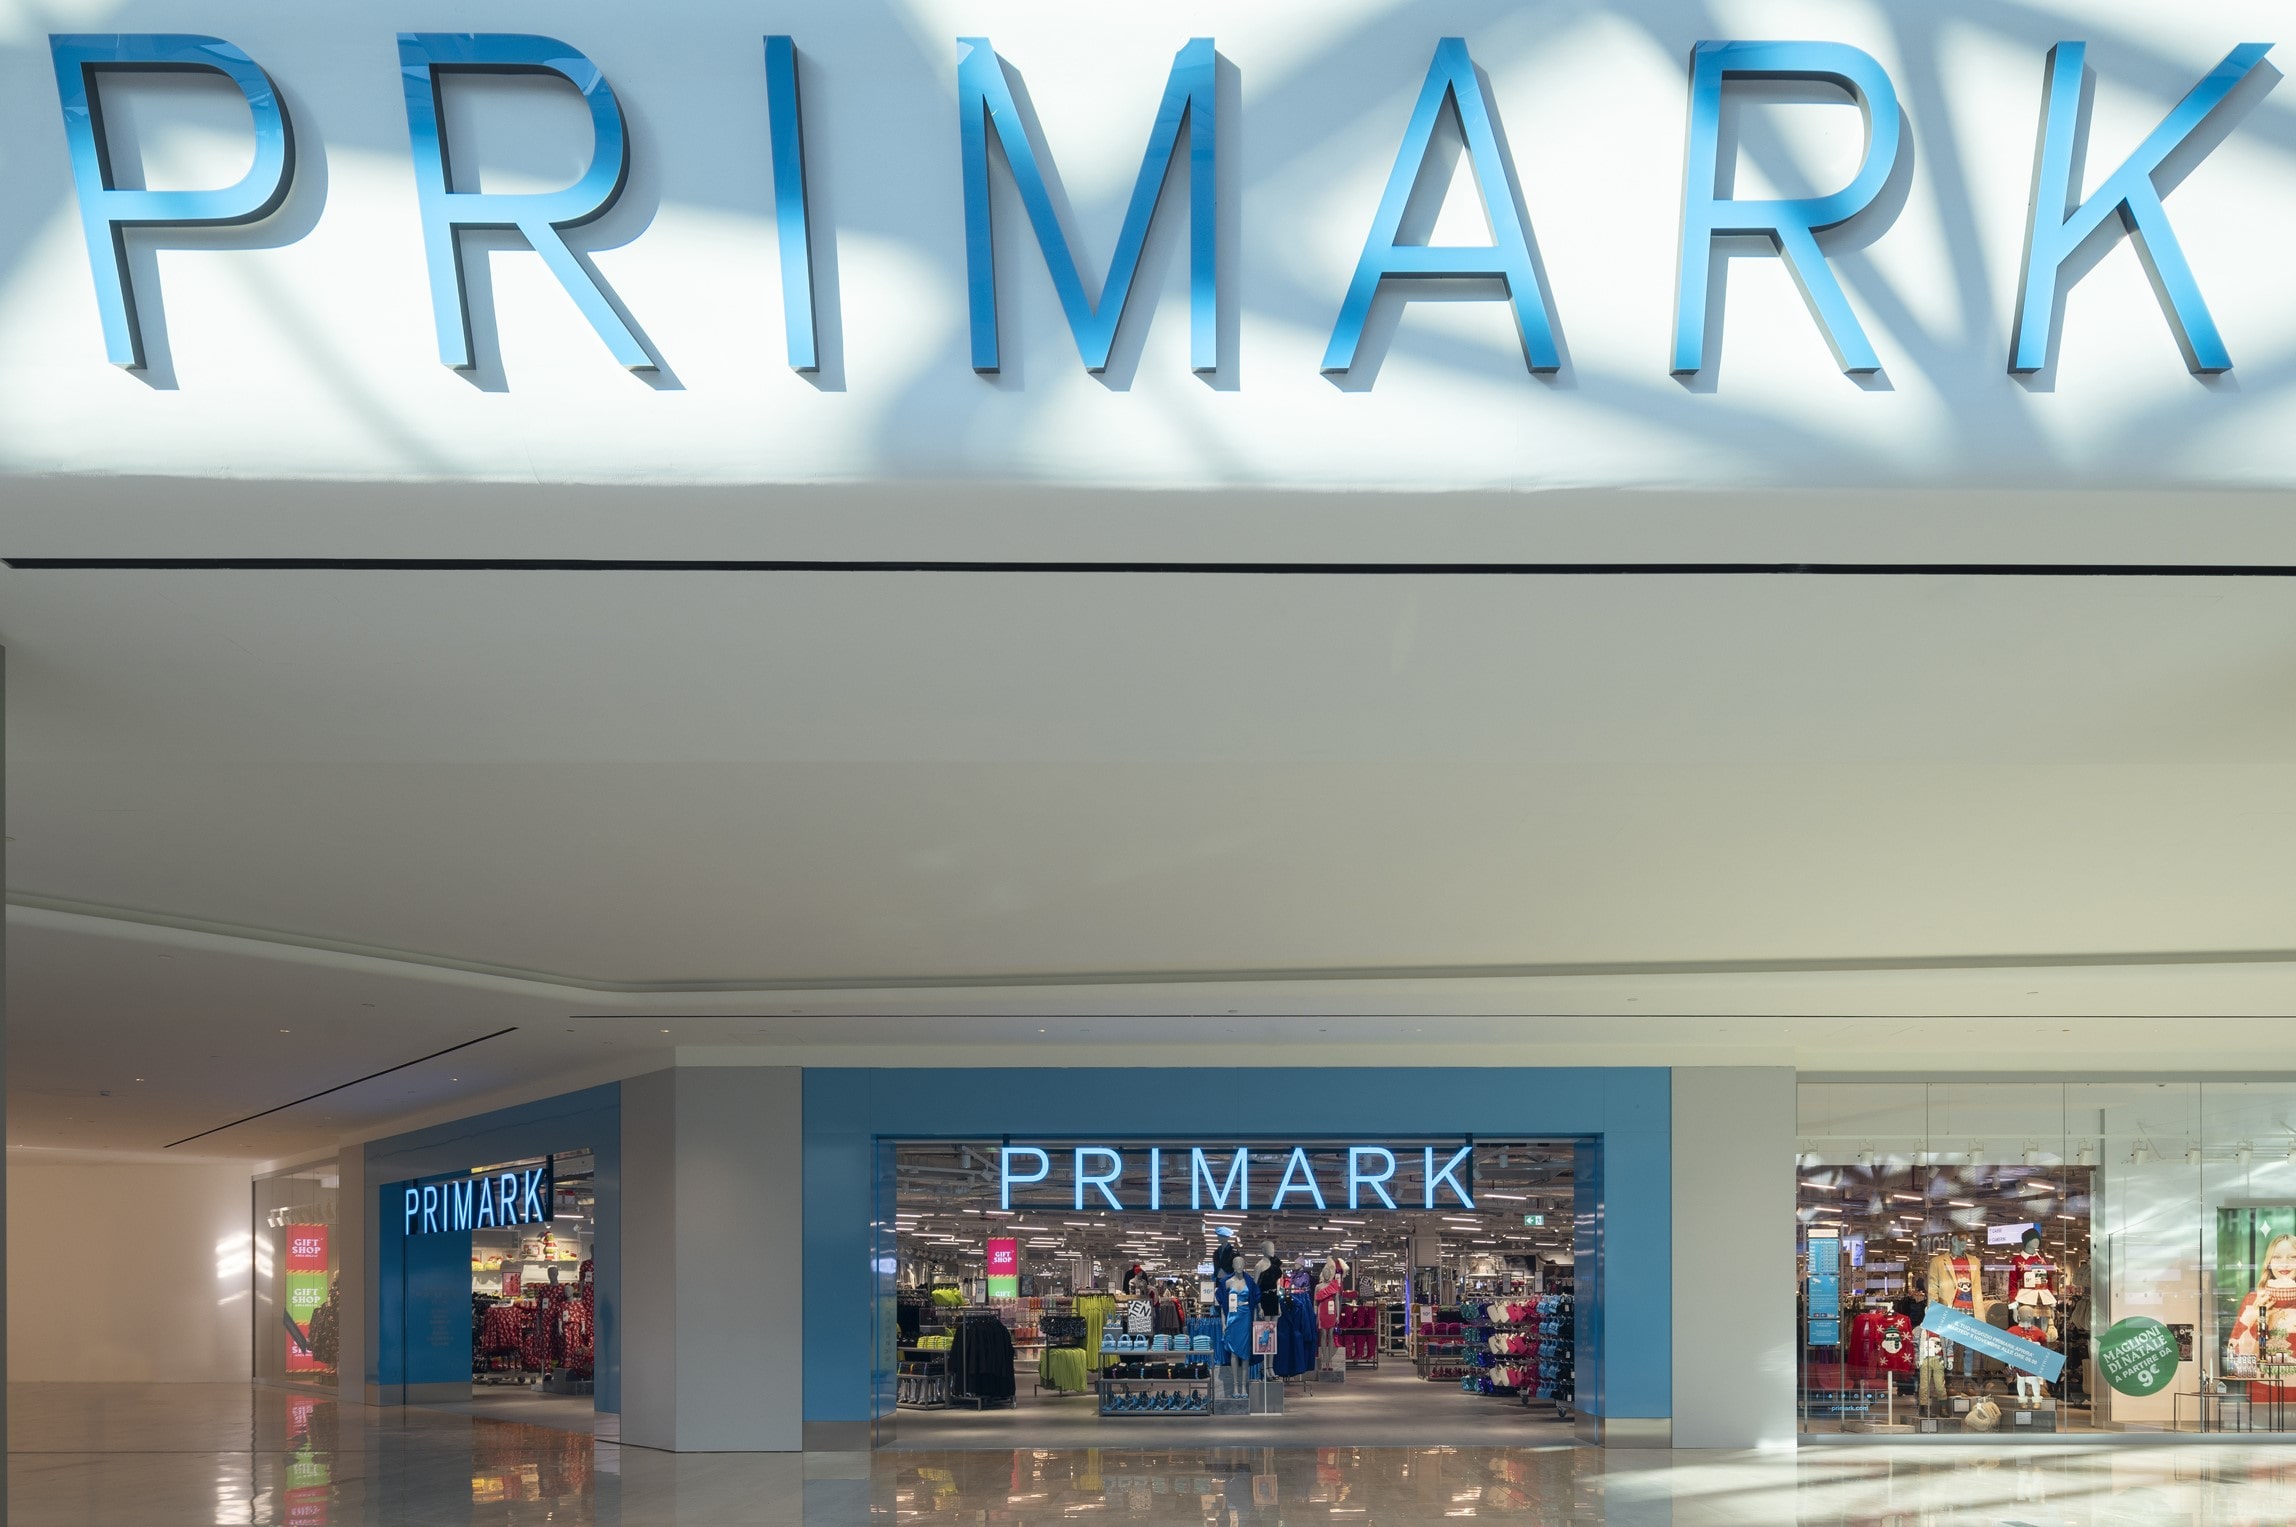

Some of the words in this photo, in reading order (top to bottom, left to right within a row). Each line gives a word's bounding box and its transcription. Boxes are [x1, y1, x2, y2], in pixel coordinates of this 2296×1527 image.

[48, 31, 2278, 374] PRIMARK
[1001, 1146, 1476, 1210] PRIMARK
[405, 1167, 544, 1236] PRIMARK
[292, 1246, 321, 1254] SHOP
[294, 1238, 319, 1247] GIFT
[292, 1296, 321, 1304] SHOP
[294, 1288, 319, 1296] GIFT
[1960, 1322, 1971, 1332] TUO
[1974, 1335, 2002, 1350] NOVEMBRE
[2102, 1325, 2161, 1363] MAGLIONI
[2107, 1360, 2123, 1374] DI
[2121, 1334, 2168, 1366] NATALE
[2114, 1375, 2123, 1383] A
[2122, 1354, 2159, 1378] PARTIRE
[2158, 1347, 2173, 1358] DA
